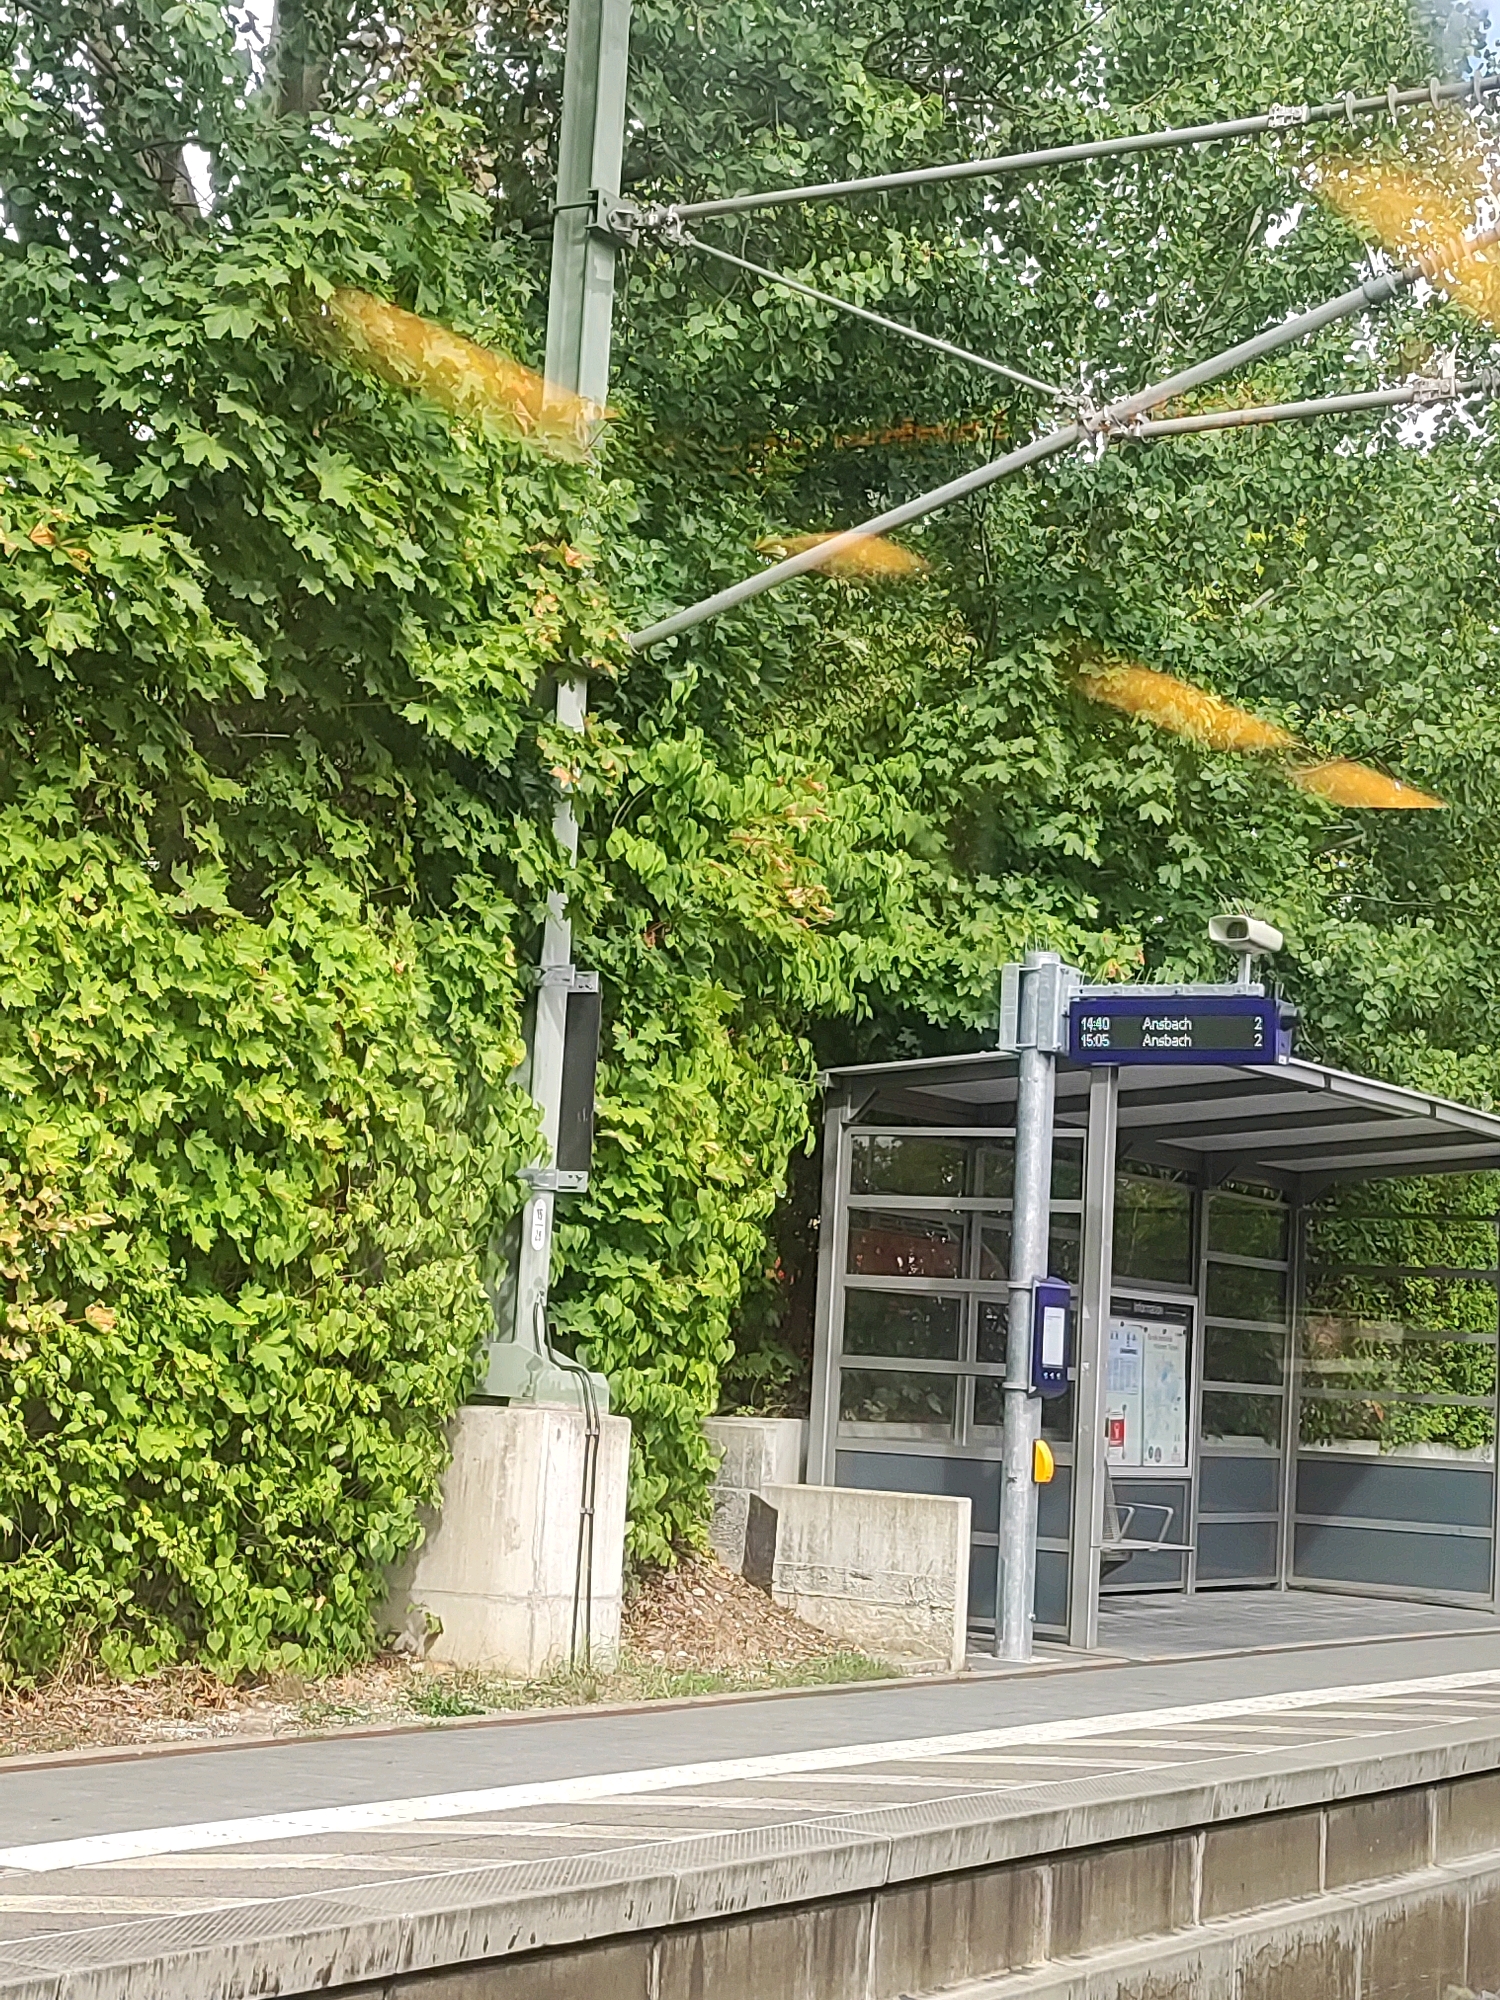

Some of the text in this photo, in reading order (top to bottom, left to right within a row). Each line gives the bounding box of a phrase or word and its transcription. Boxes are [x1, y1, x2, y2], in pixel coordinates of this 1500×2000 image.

[1081, 1016, 1263, 1031] 14:40 Ansbach 2
[1081, 1033, 1263, 1047] 15:05 Ansbach 2
